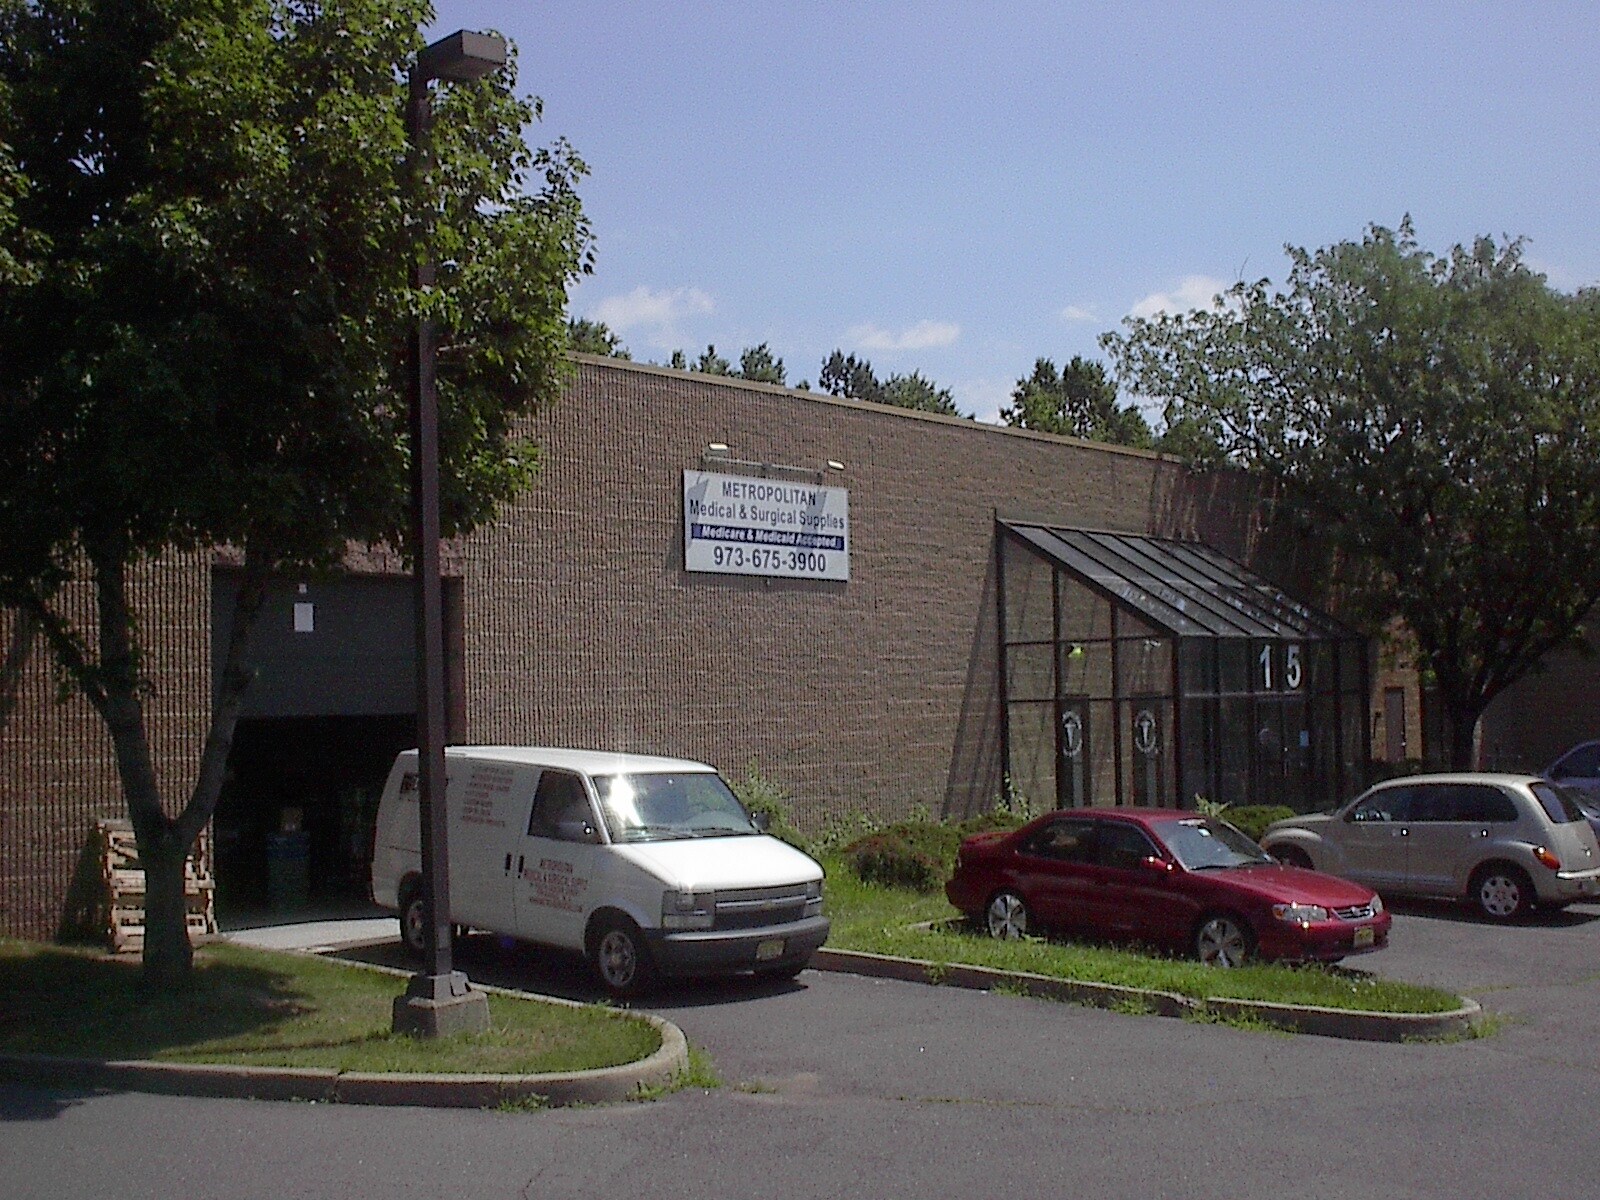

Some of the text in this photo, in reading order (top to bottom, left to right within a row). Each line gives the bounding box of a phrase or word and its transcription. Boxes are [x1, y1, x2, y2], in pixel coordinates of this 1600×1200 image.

[722, 481, 816, 506] METROPOLITAN
[690, 499, 845, 531] Medical & Surgical Supplies
[702, 525, 745, 540] Medicare
[746, 530, 753, 541] &
[755, 530, 795, 544] Medicaid
[713, 545, 826, 572] 973-675-3900
